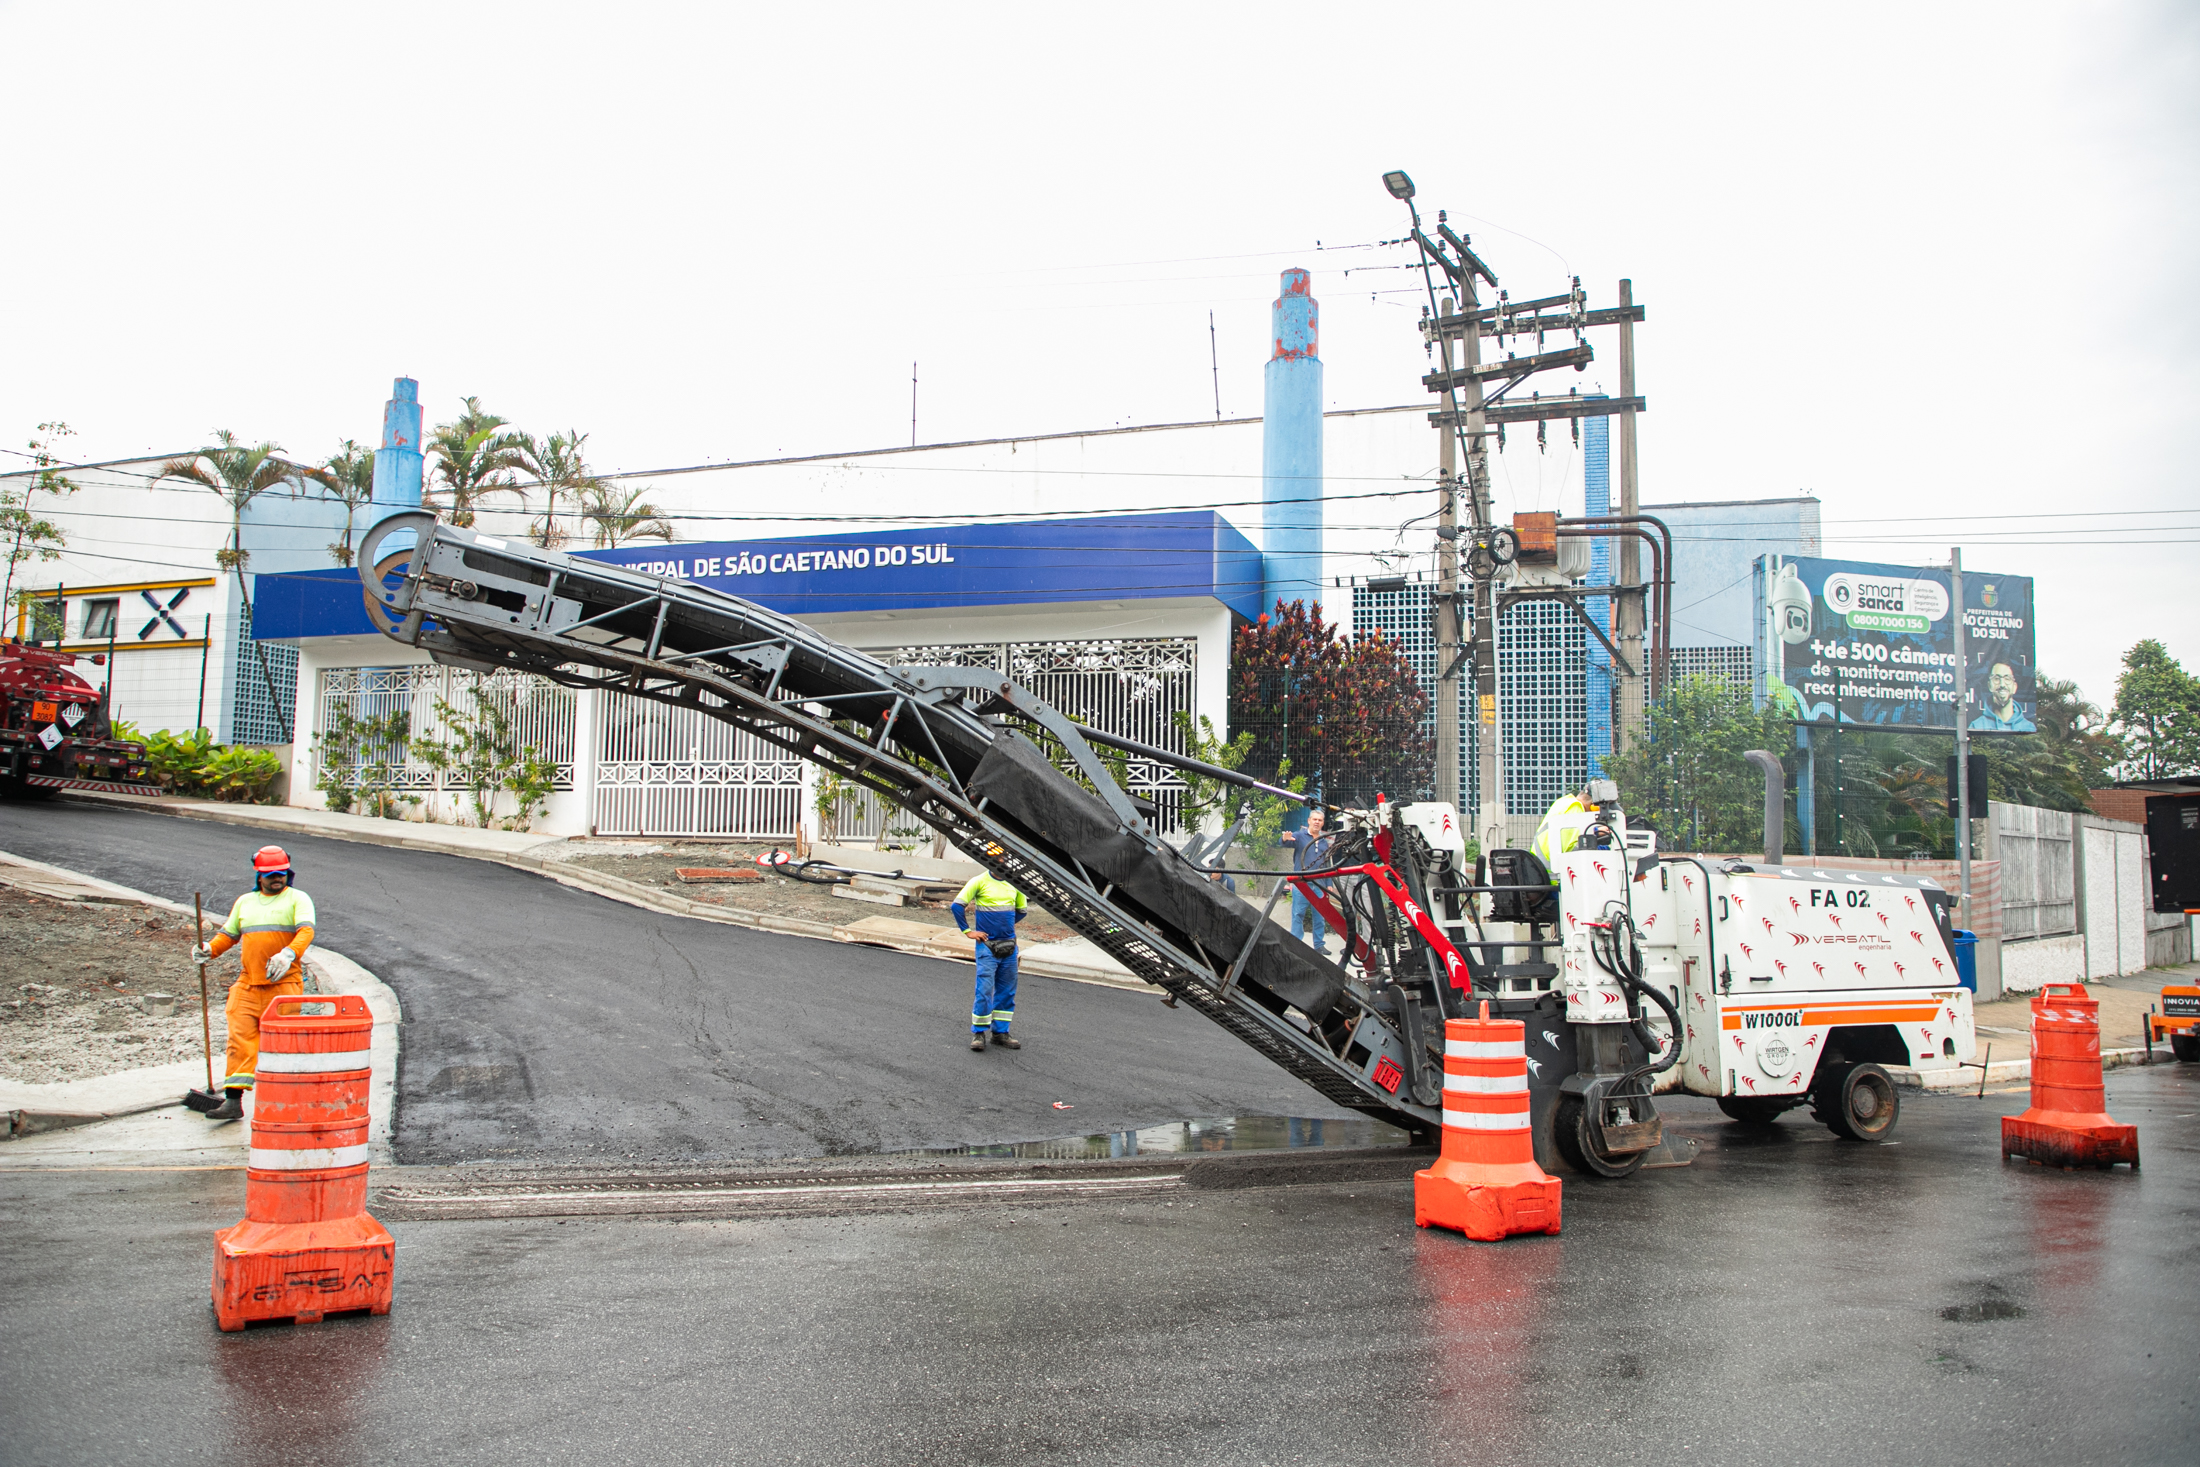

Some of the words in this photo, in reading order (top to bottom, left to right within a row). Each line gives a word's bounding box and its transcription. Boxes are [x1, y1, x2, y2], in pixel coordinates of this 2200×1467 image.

[694, 558, 721, 577] DE
[724, 551, 767, 576] SÃO
[769, 548, 870, 572] CAETANO
[875, 546, 907, 567] DO
[911, 543, 955, 565] SUL
[1858, 583, 1904, 598] smart
[1858, 597, 1904, 611] sanca
[1853, 614, 1880, 625] 0800
[1881, 616, 1905, 627] 7000
[1907, 618, 1924, 629] 156
[1962, 612, 1976, 626] ÃO
[1977, 616, 2024, 629] CAETANO
[1972, 627, 1988, 638] DO
[1989, 628, 2009, 640] SUL
[1850, 642, 1888, 662] 500
[1811, 660, 1831, 677] de
[1931, 686, 1974, 704] facl
[41, 702, 51, 711] 90
[36, 713, 53, 721] 3082
[1810, 889, 1839, 908] FA
[1846, 889, 1871, 908] 02
[1812, 935, 1891, 944] VERSATIL
[1858, 944, 1892, 952] engenharia
[2163, 998, 2200, 1006] INNOVIA
